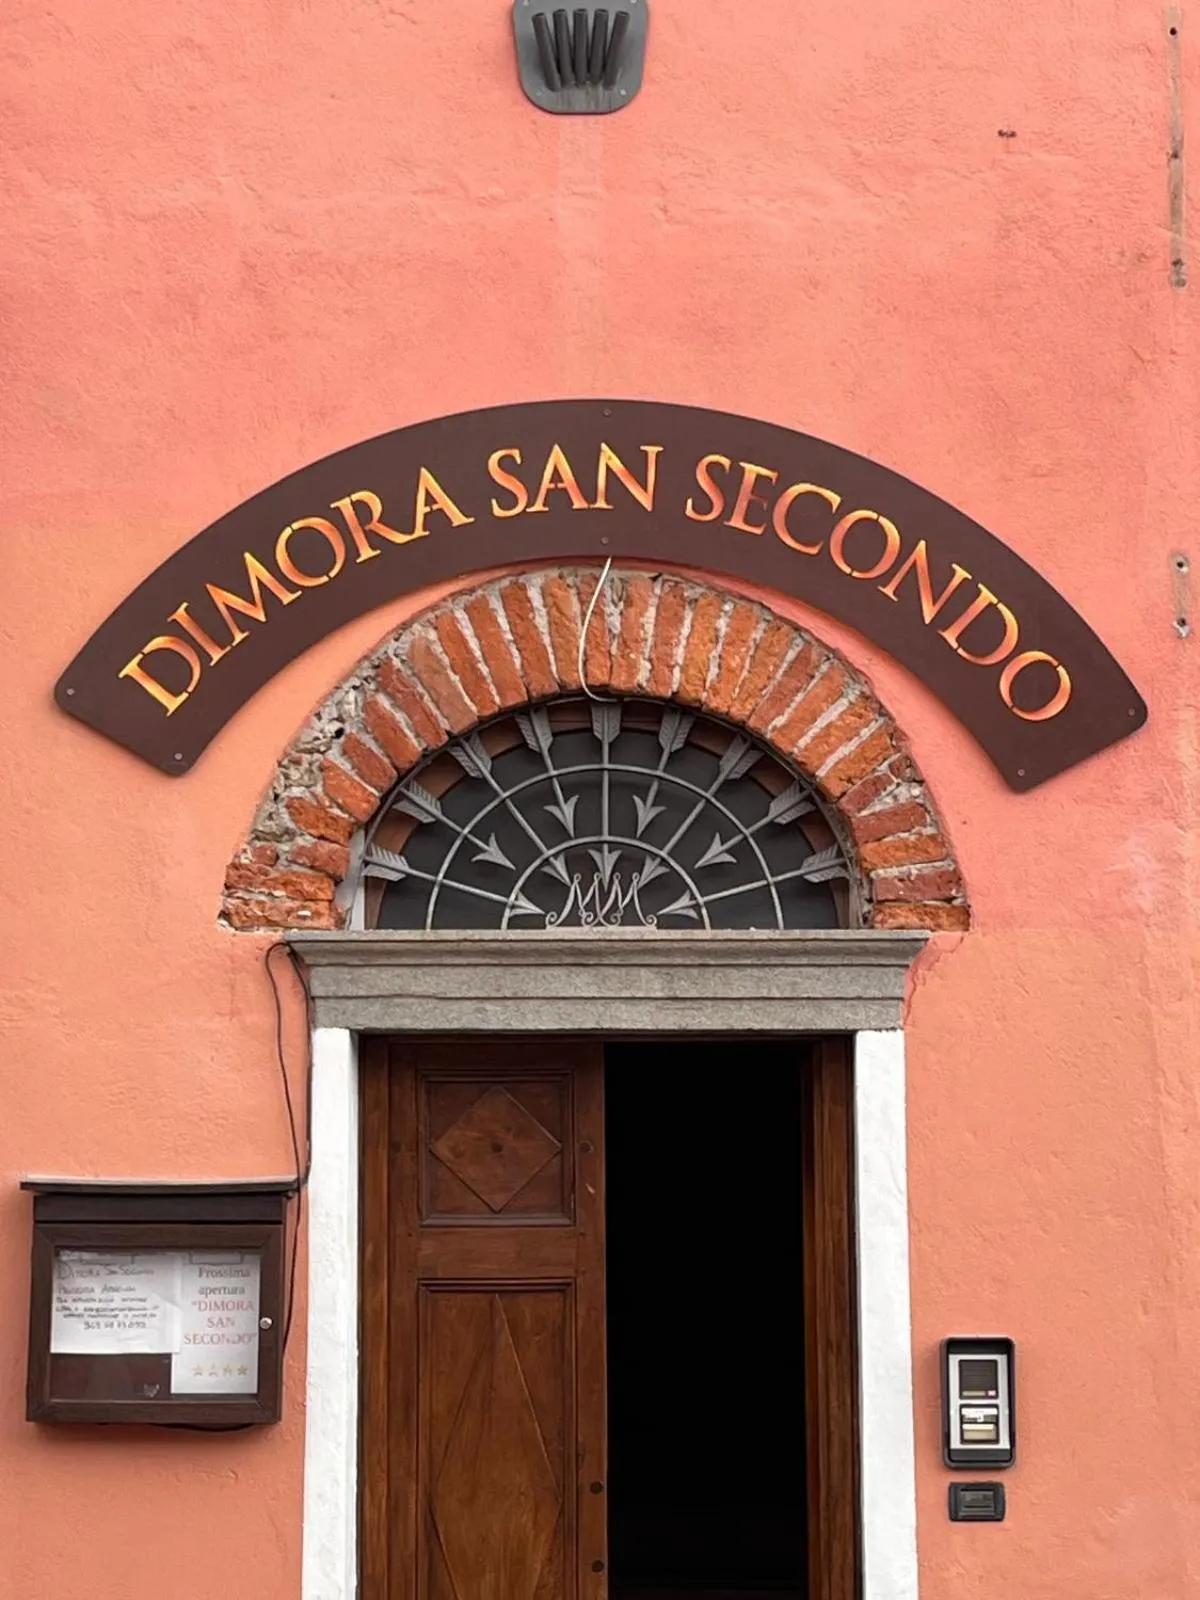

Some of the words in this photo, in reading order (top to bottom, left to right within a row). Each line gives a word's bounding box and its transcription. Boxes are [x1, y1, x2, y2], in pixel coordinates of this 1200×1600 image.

[118, 466, 475, 718] DIMORA
[486, 442, 664, 518] SAN
[685, 454, 1072, 722] SECONDO
[198, 1286, 246, 1298] apertura
